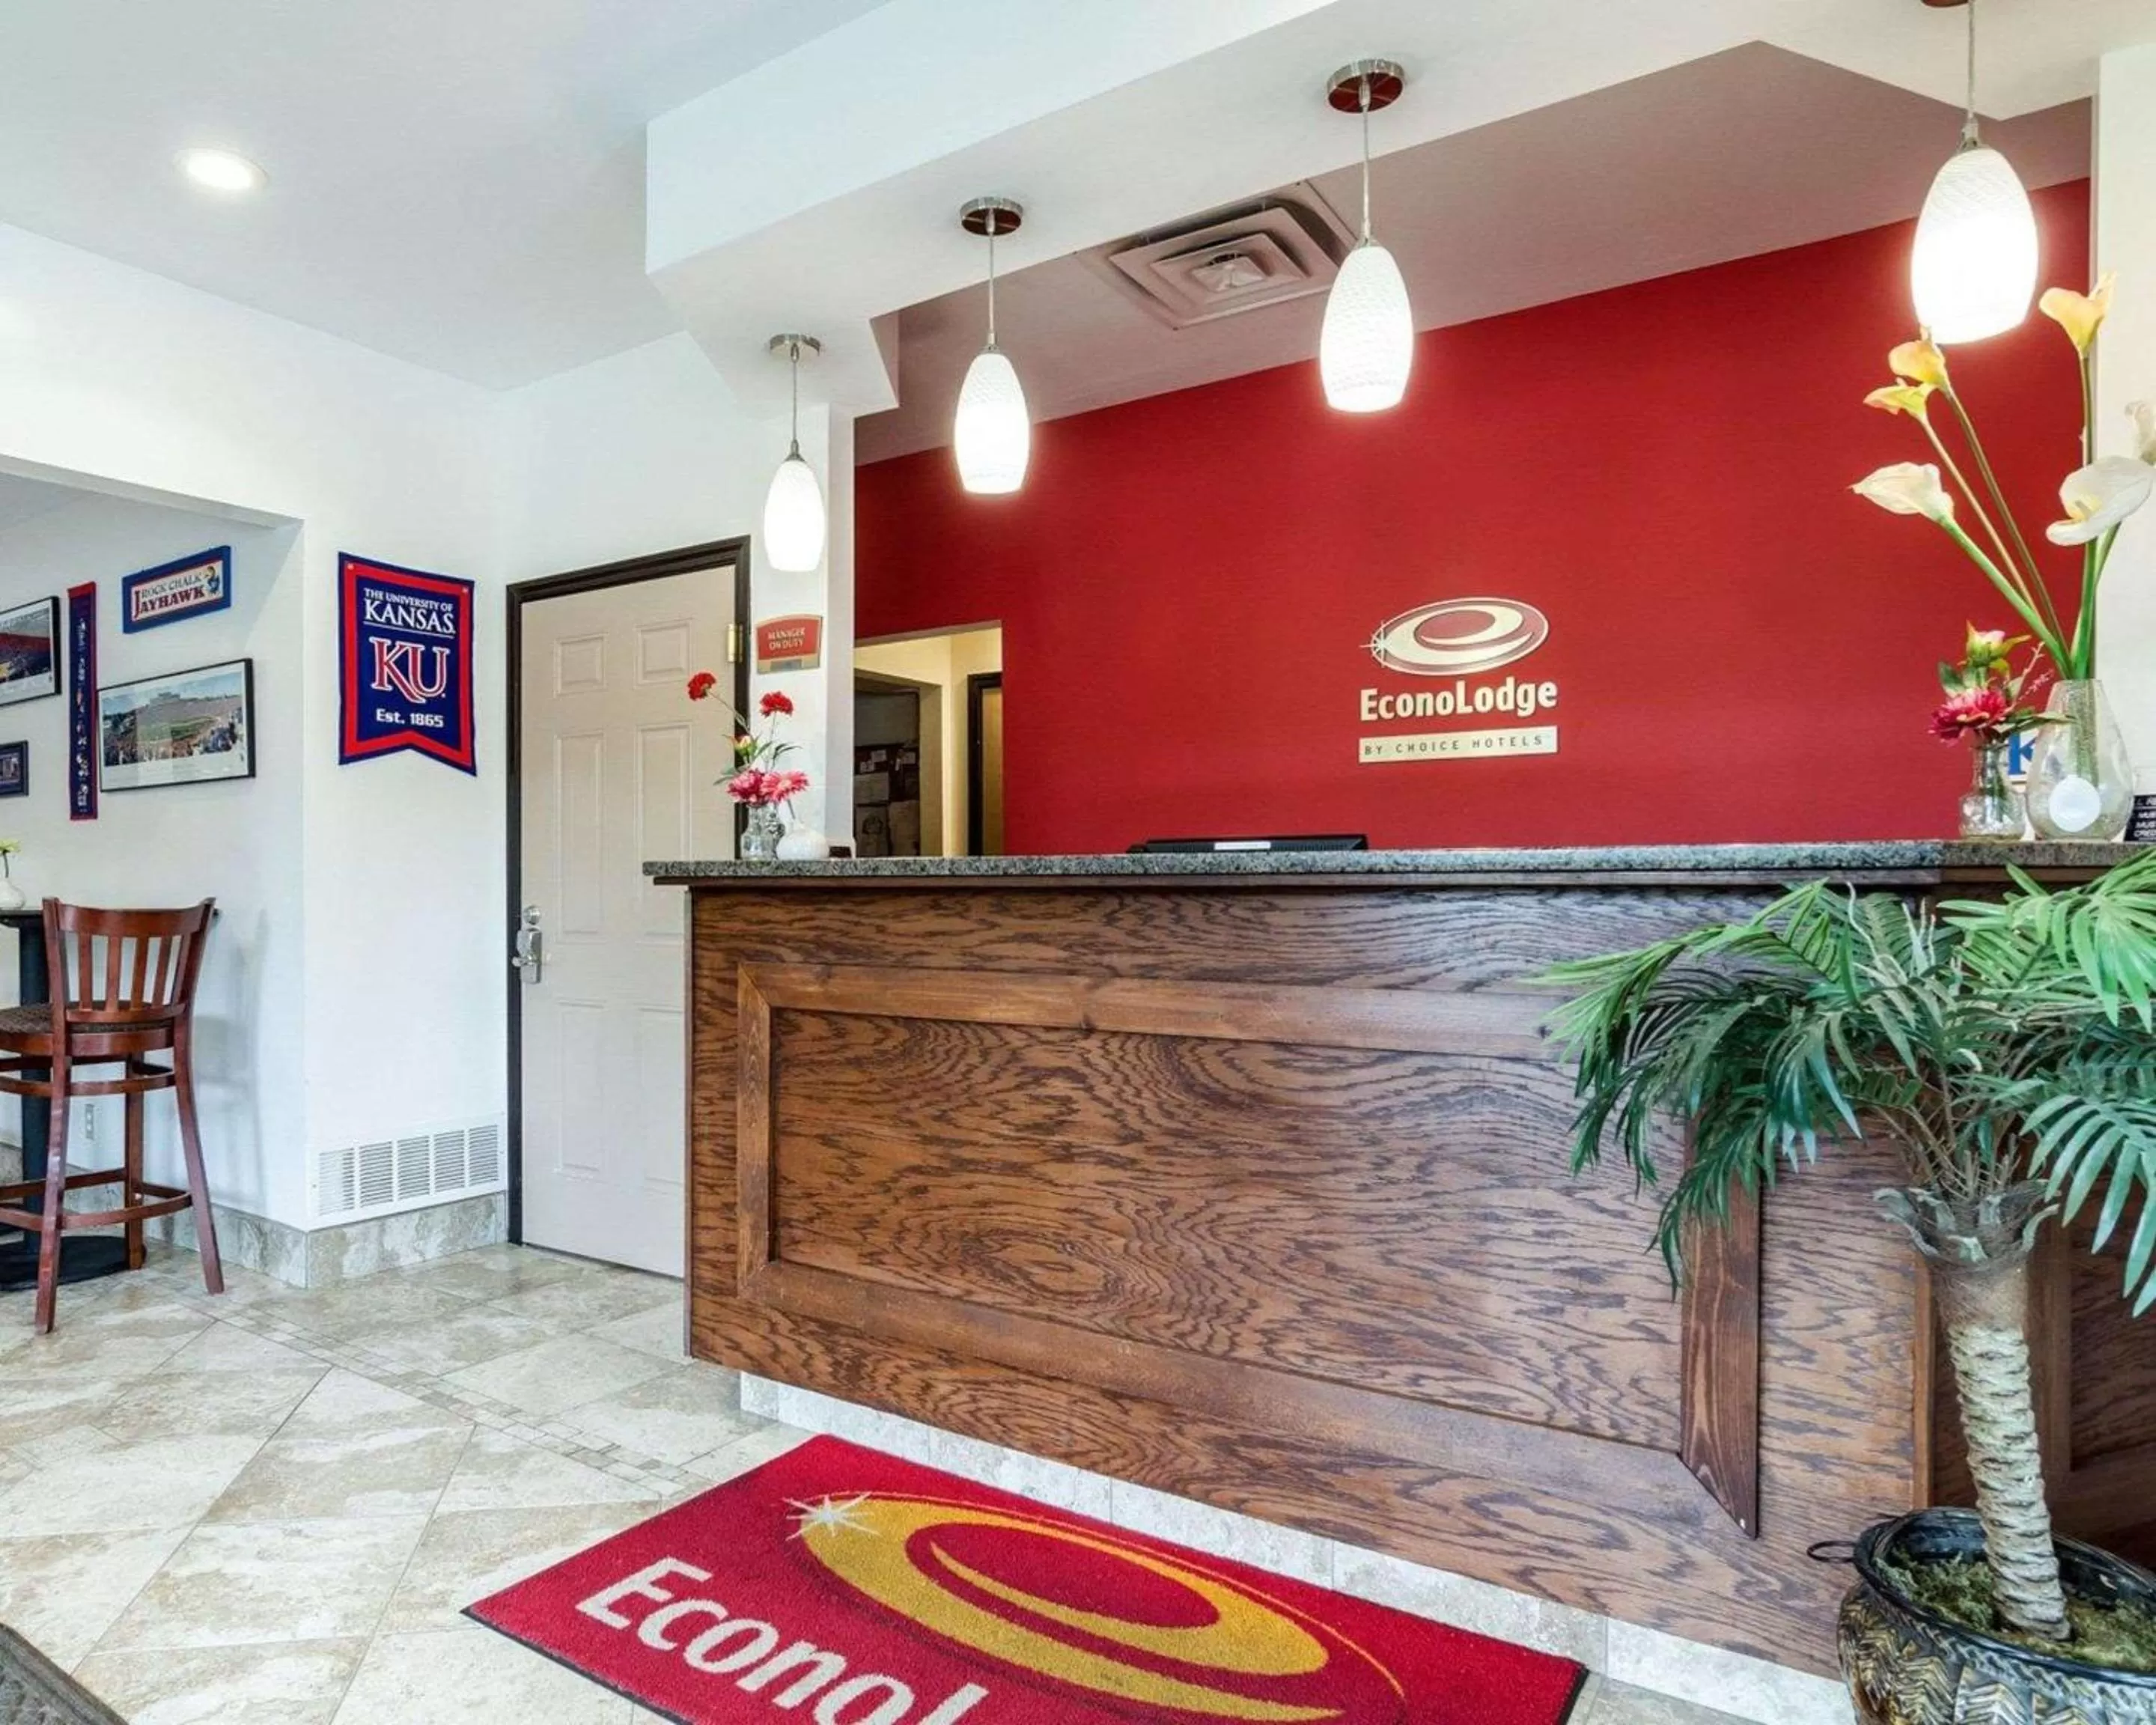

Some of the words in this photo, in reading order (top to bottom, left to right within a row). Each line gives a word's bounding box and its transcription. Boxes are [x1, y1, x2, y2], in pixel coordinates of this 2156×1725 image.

[141, 583, 167, 598] ROCK
[168, 573, 202, 591] CHALK
[364, 587, 384, 600] THE
[386, 591, 440, 610] UNIVERSITY
[440, 602, 453, 612] OF
[134, 584, 205, 619] JAYHAWK
[364, 598, 455, 634] KANSAS
[368, 636, 450, 704] KU
[1359, 676, 1558, 721] EconoLodge
[376, 708, 405, 725] Est.
[409, 712, 444, 728] 1865
[1364, 745, 1383, 755] BY
[1395, 739, 1460, 754] CHOICE
[1472, 734, 1543, 749] HOTELS
